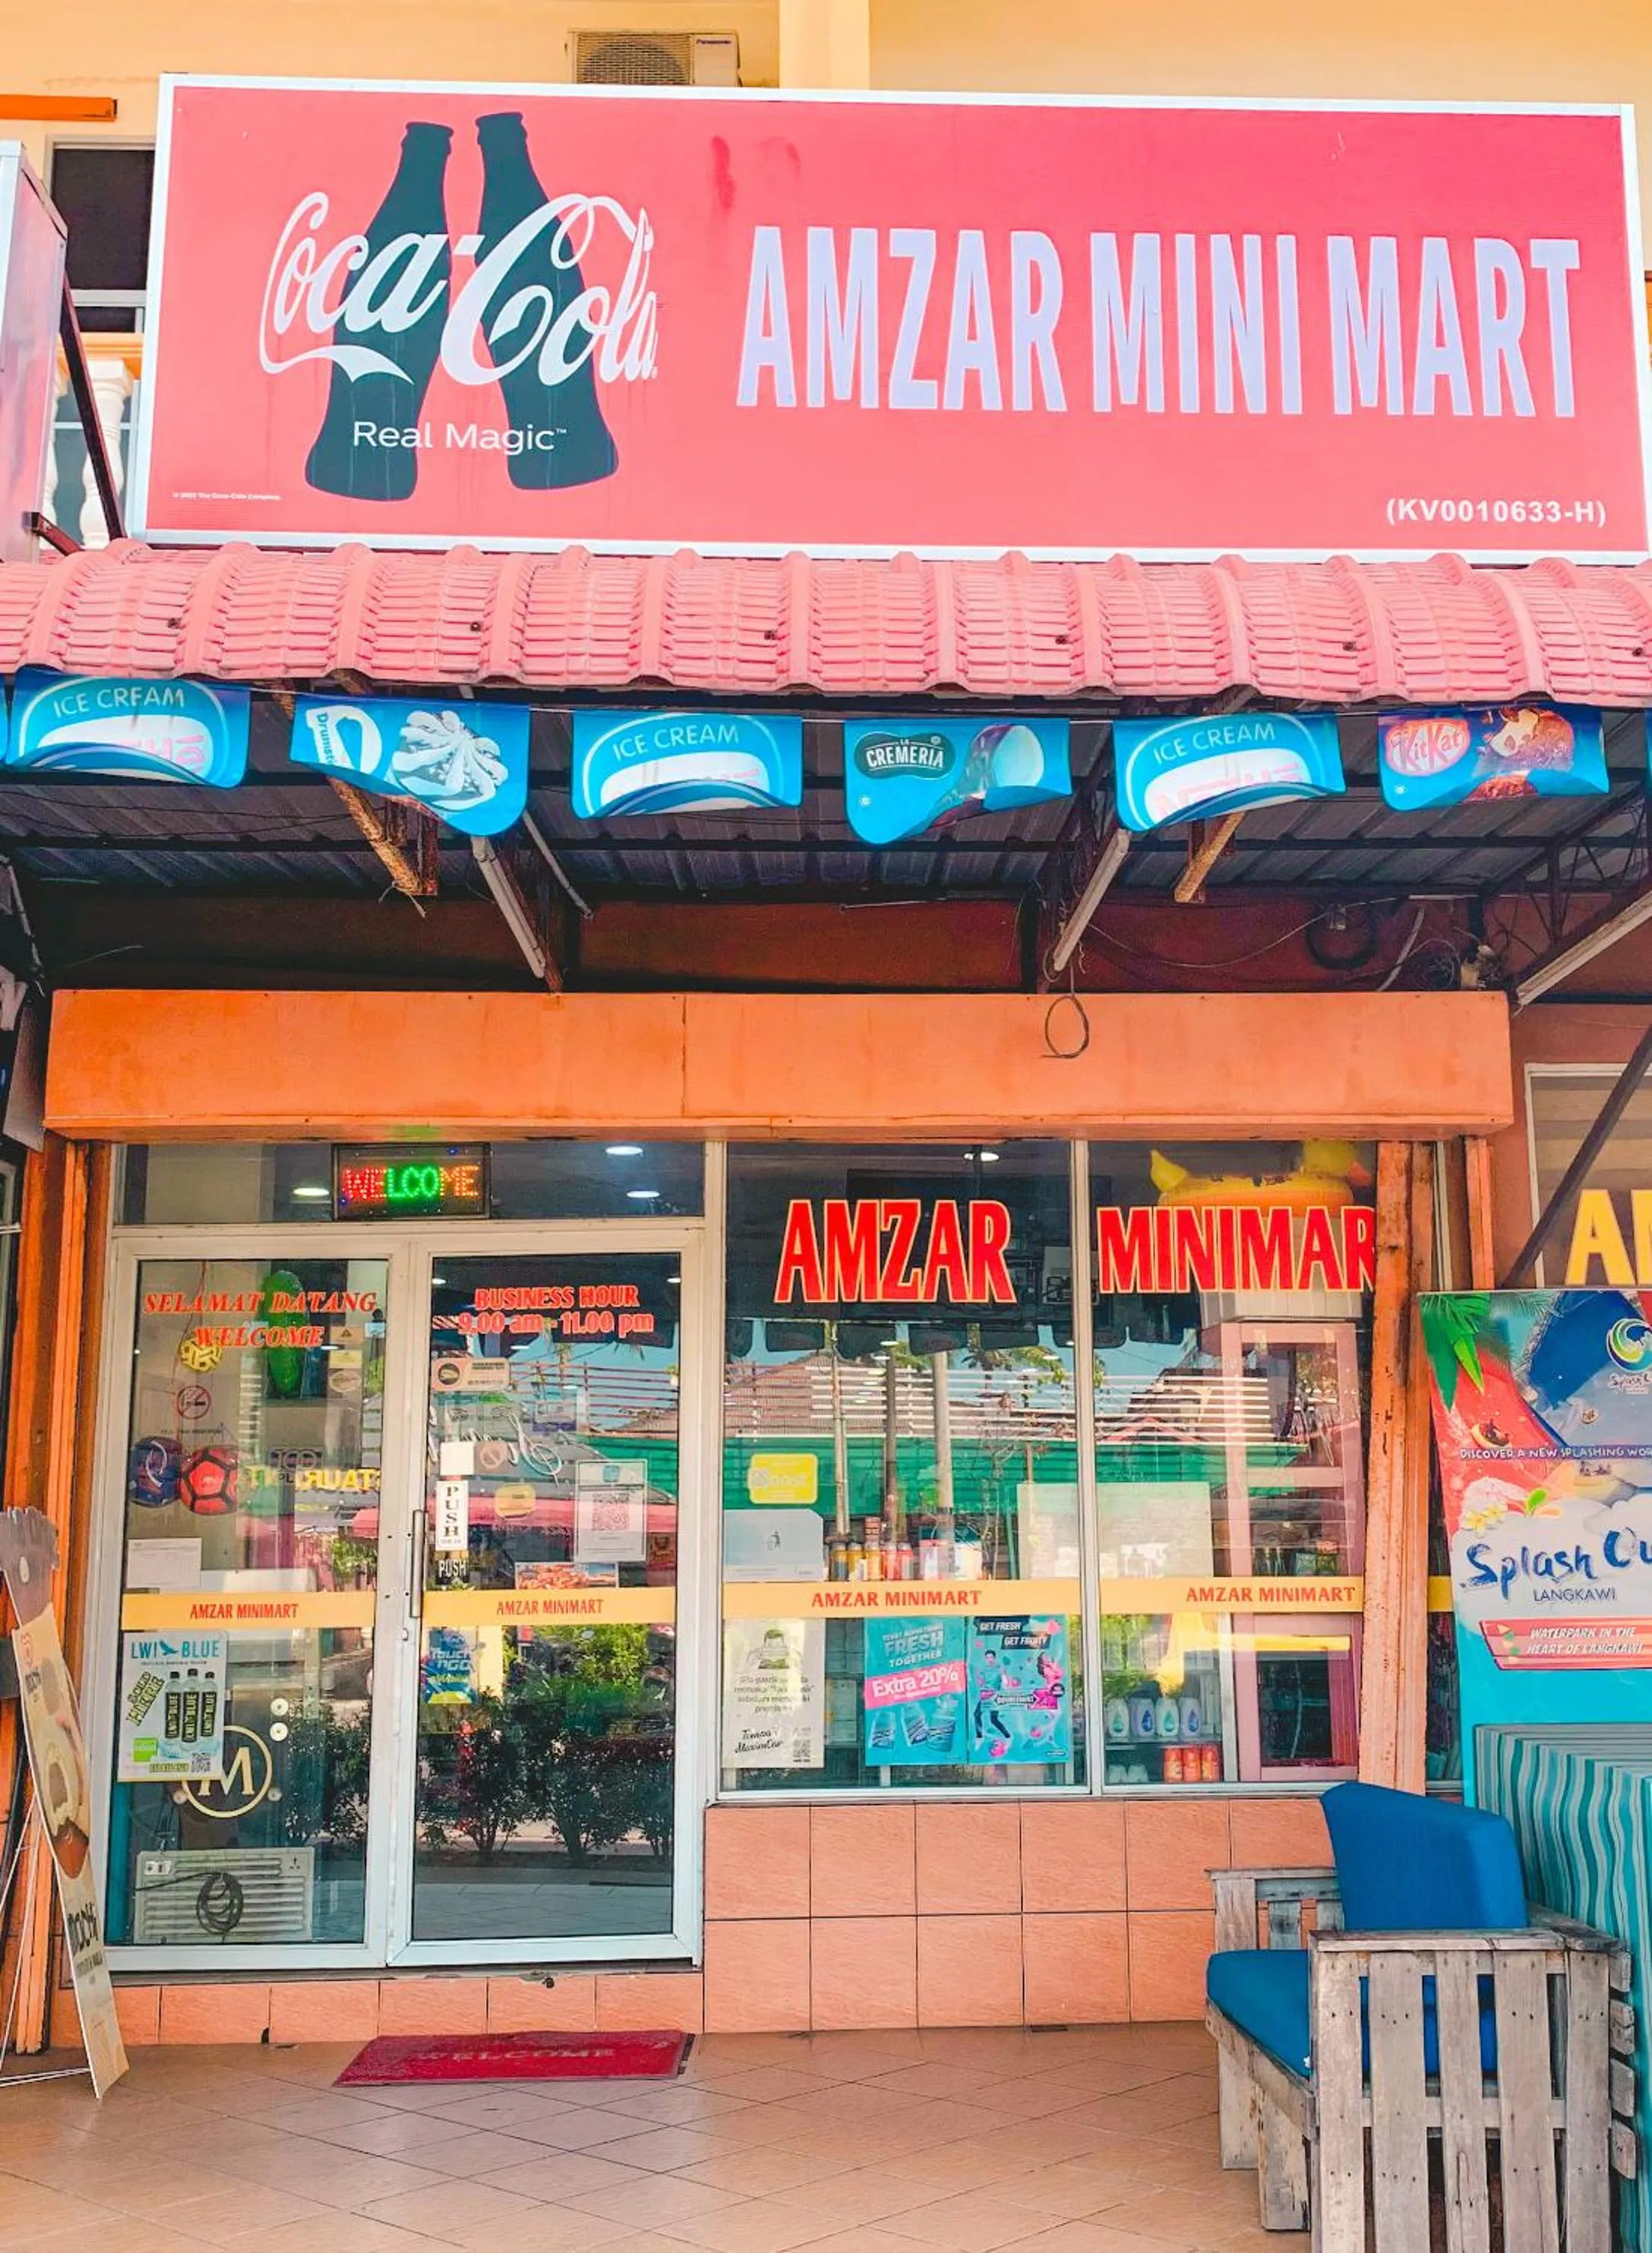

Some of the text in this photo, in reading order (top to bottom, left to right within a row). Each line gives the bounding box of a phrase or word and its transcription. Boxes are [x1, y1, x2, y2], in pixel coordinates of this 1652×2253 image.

[259, 191, 658, 386] Coca-Cola
[737, 226, 1580, 418] AMZAR MINI MART
[353, 421, 431, 449] Real
[1385, 498, 1606, 527] (KV0010633-H)
[52, 687, 185, 719] ICE CREAM
[316, 712, 334, 763] Drumst
[612, 724, 739, 762] ICE CREAM
[1153, 722, 1276, 766] ICE CREAM
[866, 746, 944, 768] CREMERIA
[343, 1166, 480, 1199] WELCOME
[774, 1199, 1018, 1303] AMZAR
[144, 1291, 377, 1313] SELAMAT DATANG
[475, 1285, 640, 1310] BUSINESS HOUR
[457, 1312, 506, 1335] 9.00
[508, 1314, 544, 1333] am
[560, 1311, 614, 1334] 11.00
[618, 1313, 655, 1338] pm
[194, 1326, 325, 1348] WELCOME
[1460, 1448, 1514, 1458] DISCOVER
[1529, 1448, 1557, 1458] NEW
[1561, 1446, 1624, 1458] SPLASHING
[445, 1486, 459, 1537] PUSH
[438, 1559, 467, 1578] PUSH
[1461, 1543, 1598, 1600] Splash
[812, 1591, 981, 1608] AMZAR MINIMART
[1186, 1586, 1357, 1603] AMZAR MINIMART
[1533, 1588, 1616, 1602] LANGKAWI
[191, 1603, 298, 1619] AMZAR MINIMART
[497, 1598, 605, 1616] AMZAR MINIMART
[980, 1622, 1021, 1631] GET FRESH
[1530, 1626, 1637, 1639] WATERPARK IN THE
[131, 1640, 220, 1659] LWI BLUE
[883, 1629, 943, 1657] FRESH
[1004, 1637, 1019, 1646] GET
[1565, 1644, 1581, 1654] OF
[889, 1649, 943, 1667] TOGETHER
[872, 1676, 918, 1698] Extra
[918, 1664, 959, 1689] 20%
[185, 1693, 196, 1716] BLUE
